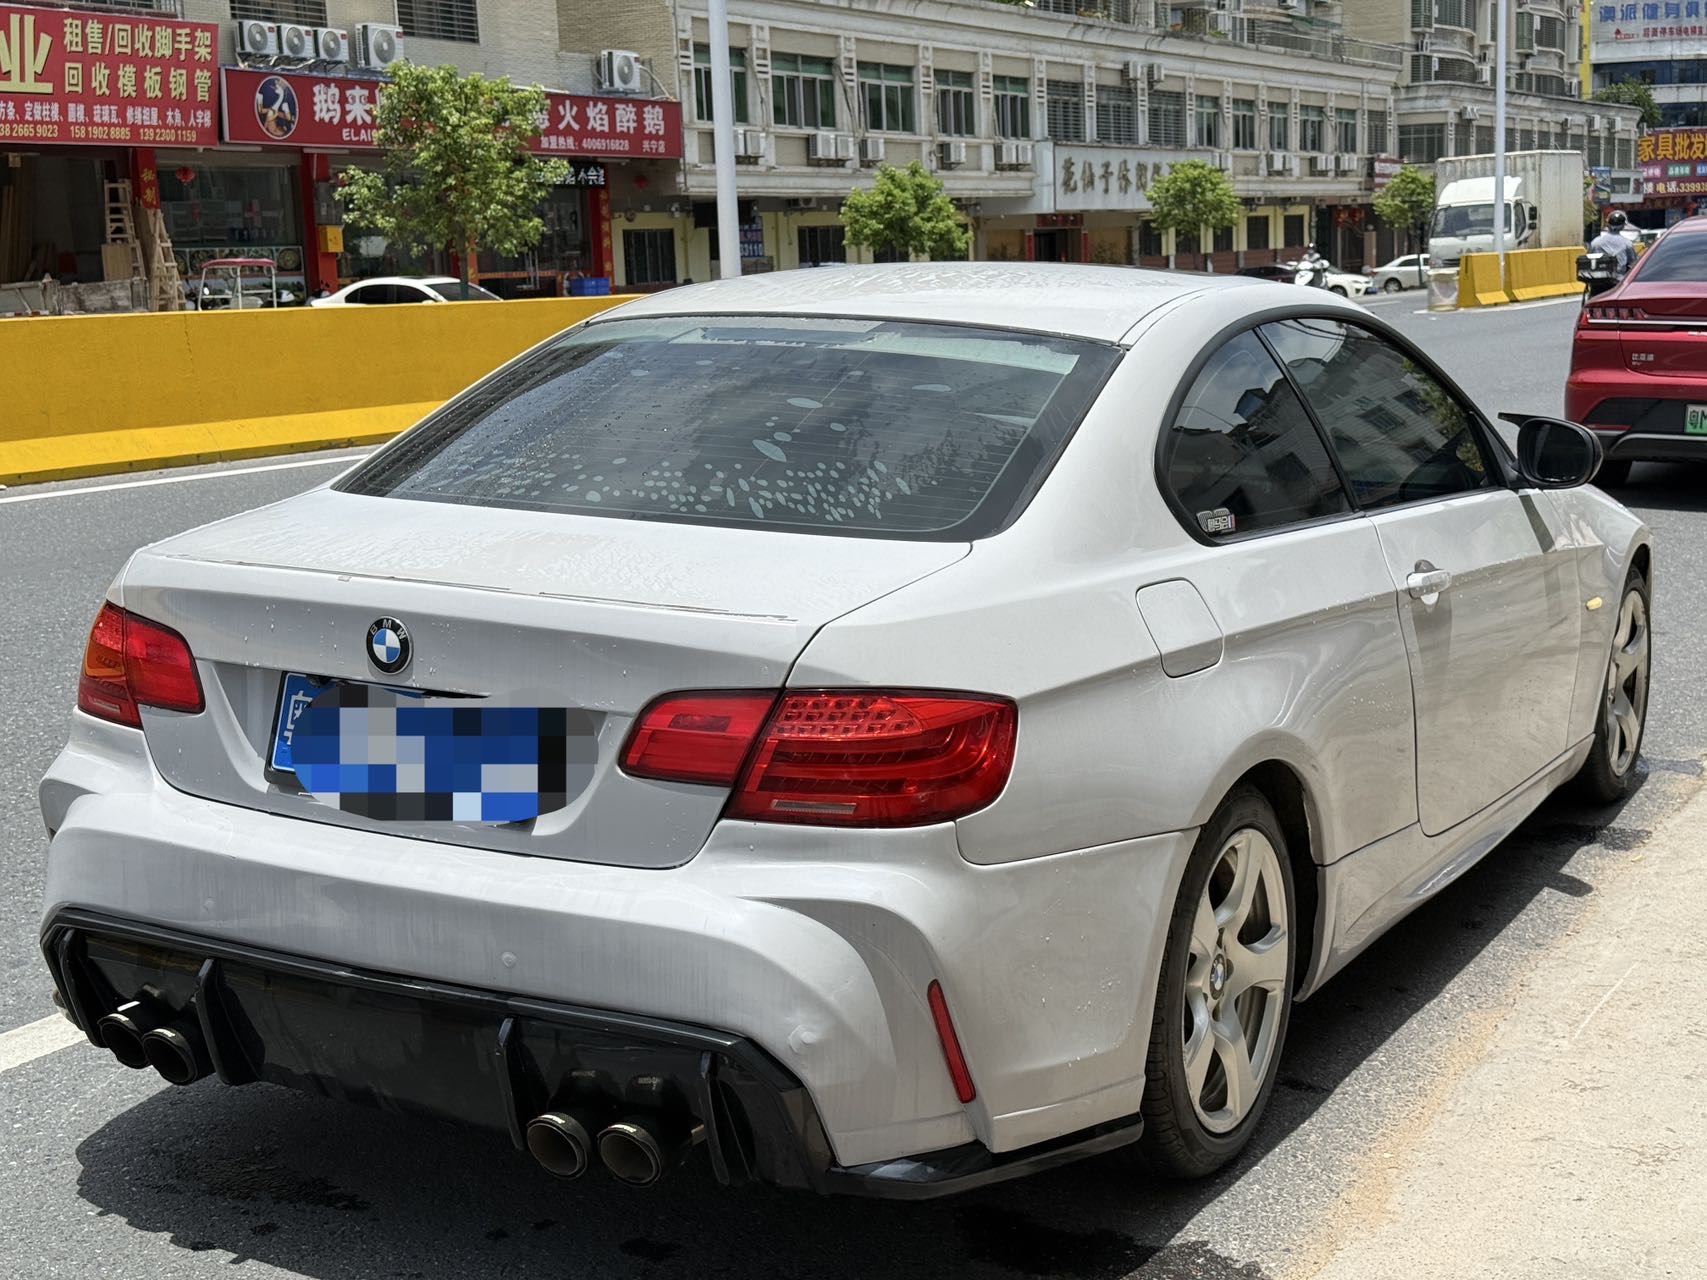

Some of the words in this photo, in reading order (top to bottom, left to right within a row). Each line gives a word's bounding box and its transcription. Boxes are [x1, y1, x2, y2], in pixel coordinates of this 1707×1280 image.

[0, 13, 53, 93] 业
[64, 17, 212, 62] 租售/回收脚手架
[64, 62, 212, 102] 回收模板钢管
[312, 83, 385, 125] 鹅来
[12, 123, 35, 137] 2665
[36, 124, 59, 138] 9023
[70, 125, 86, 139] 158
[88, 126, 109, 140] 1902
[109, 127, 131, 140] 8885
[140, 128, 154, 141] 139
[155, 128, 176, 142] 2300
[178, 129, 197, 142] 1159
[1637, 133, 1707, 162] 家具批发
[370, 619, 407, 640] BMW
